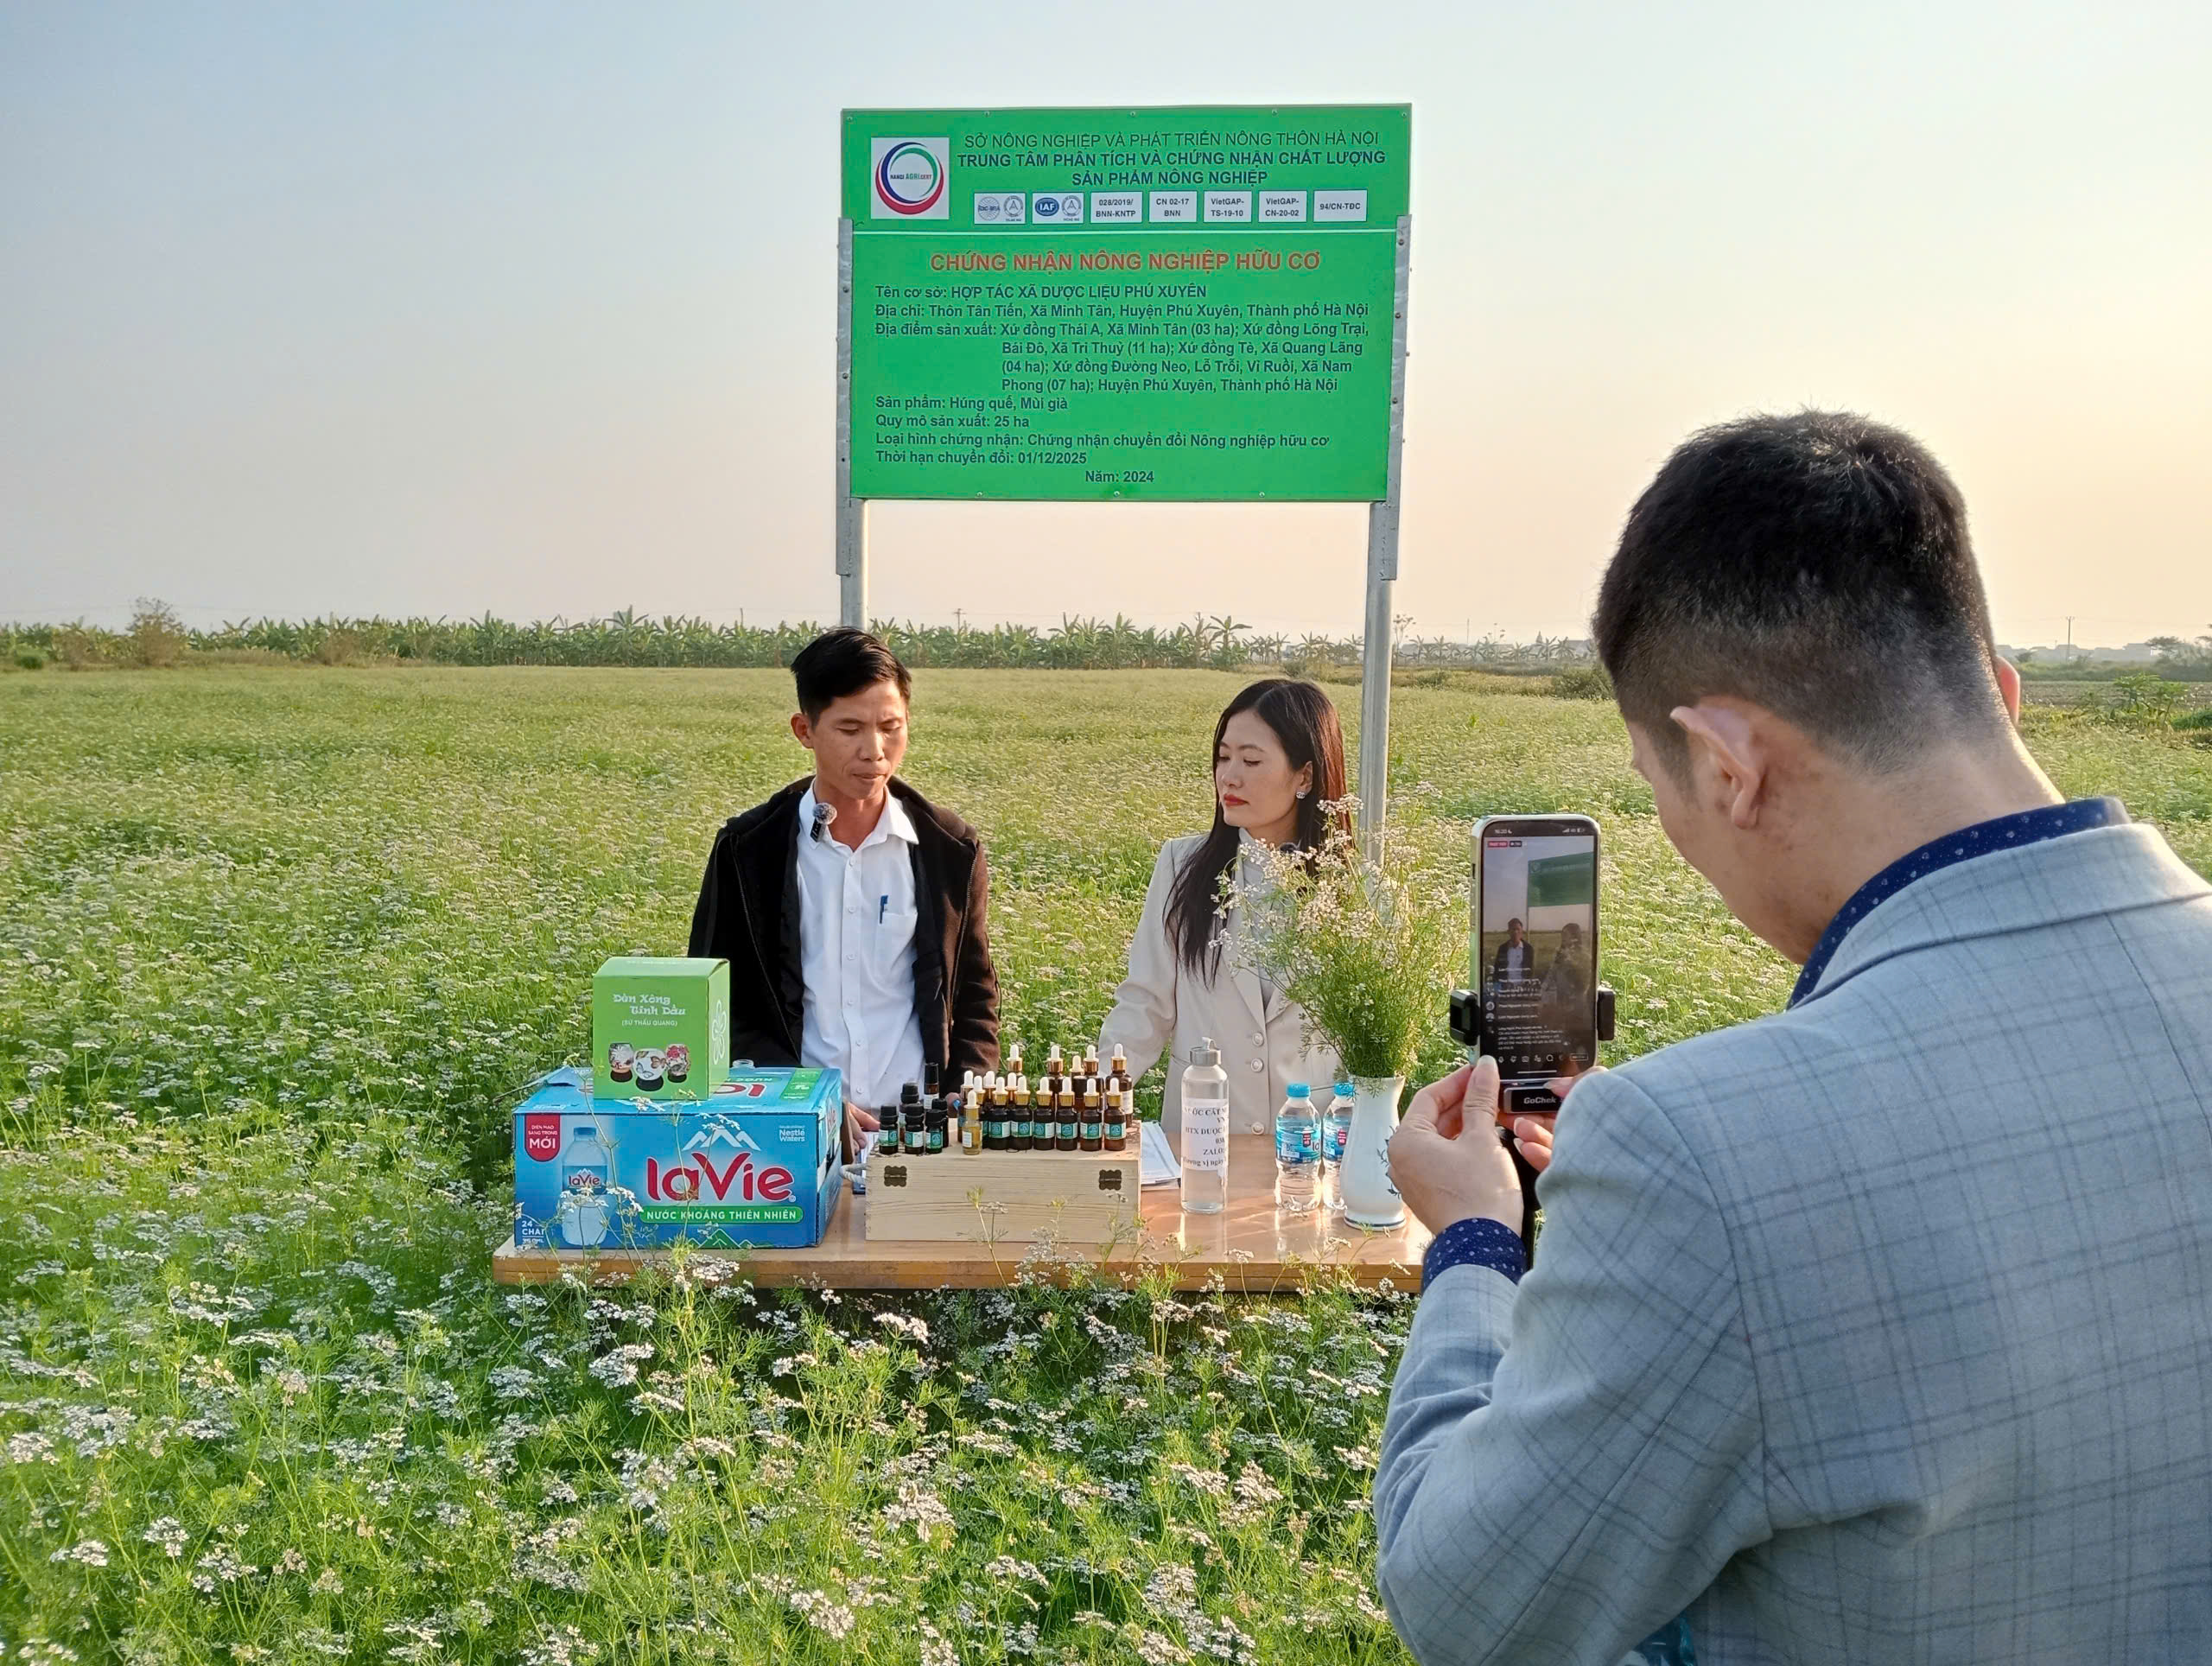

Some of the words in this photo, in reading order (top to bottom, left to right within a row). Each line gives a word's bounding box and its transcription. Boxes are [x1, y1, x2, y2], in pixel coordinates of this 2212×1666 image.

[964, 132, 988, 148] SỞ
[993, 132, 1038, 148] NÔNG
[1042, 132, 1101, 150] NGHIỆP
[1104, 131, 1125, 148] VÀ
[1129, 131, 1171, 147] PHÁT
[1225, 130, 1272, 146] NÔNG
[1276, 130, 1320, 146] THÔN
[1325, 130, 1347, 145] HÀ
[1351, 130, 1379, 147] NỘI
[957, 154, 1012, 167] TRUNG
[1015, 150, 1049, 167] TÂM
[1052, 150, 1096, 167] PHÂN
[1100, 149, 1137, 166] TÍCH
[1141, 149, 1162, 165] VÀ
[1166, 149, 1224, 165] CHỨNG
[1230, 149, 1274, 168] NHẬN
[1278, 149, 1322, 165] CHẤT
[1326, 149, 1386, 167] LƯỢNG
[1072, 169, 1103, 186] SẢN
[1158, 168, 1205, 184] NÔNG
[1209, 168, 1268, 187] NGHIỆP
[1098, 198, 1134, 207] 028/2019/
[1319, 202, 1361, 211] 94/CN-TĐC
[930, 250, 1007, 271] CHỨNG
[1013, 250, 1072, 275] NHẬN
[1079, 249, 1141, 270] NÔNG
[1148, 249, 1230, 274] NGHIỆP
[1236, 249, 1281, 270] HỮU
[1287, 251, 1321, 270] CƠ
[875, 285, 900, 298] Tên
[904, 289, 922, 298] cơ
[951, 285, 982, 302] HỢP
[986, 283, 1014, 298] TÁC
[1017, 283, 1038, 298] XÃ
[1041, 285, 1085, 301] DƯỢC
[1088, 283, 1120, 301] LIỆU
[1124, 282, 1154, 298] PHÚ
[1157, 283, 1206, 297] XUYÊN
[874, 303, 897, 319] Địa
[900, 303, 925, 317] chỉ:
[929, 304, 963, 316] Thôn
[966, 304, 991, 316] Tân
[1029, 304, 1047, 316] Xã
[1051, 304, 1083, 316] Minh
[1087, 304, 1116, 318] Tân,
[1120, 304, 1162, 320] Huyện
[1166, 303, 1193, 316] Phú
[1197, 304, 1243, 320] Xuyên,
[1246, 303, 1289, 316] Thành
[1293, 302, 1319, 319] phố
[1323, 303, 1341, 316] Hà
[1345, 302, 1369, 318] Nội
[874, 322, 897, 338] Địa
[900, 321, 933, 335] điểm
[936, 323, 961, 335] sản
[963, 321, 996, 335] xuất:
[1001, 322, 1020, 335] Xứ
[1023, 321, 1056, 338] đồng
[1090, 323, 1103, 337] A,
[1107, 322, 1124, 335] Xã
[1128, 322, 1160, 335] Minh
[1163, 322, 1187, 335] Tân
[1191, 323, 1211, 338] (03
[1214, 323, 1239, 338] ha);
[1243, 322, 1263, 335] Xứ
[1266, 321, 1300, 337] đồng
[1341, 321, 1369, 337] Trại,
[1051, 341, 1068, 353] Xã
[1128, 341, 1146, 356] (11
[1150, 341, 1175, 356] ha);
[1178, 341, 1198, 353] Xứ
[1201, 340, 1235, 356] đồng
[1262, 341, 1278, 353] Xã
[1281, 341, 1326, 356] Quang
[1001, 360, 1021, 375] (04
[1025, 360, 1049, 375] ha);
[1052, 360, 1072, 372] Xứ
[1075, 358, 1108, 375] đồng
[1111, 360, 1158, 375] Đường
[1161, 360, 1191, 374] Neo,
[1300, 359, 1319, 372] Xã
[1322, 359, 1352, 372] Nam
[1001, 378, 1044, 394] Phong
[1046, 378, 1066, 393] (07
[1070, 378, 1094, 393] ha);
[1098, 378, 1140, 394] Huyện
[1143, 378, 1168, 391] Phú
[1172, 378, 1217, 393] Xuyên,
[1220, 378, 1262, 391] Thành
[1265, 376, 1291, 393] phố
[1294, 378, 1312, 391] Hà
[1315, 378, 1338, 394] Nội
[875, 395, 901, 409] Sản
[905, 393, 946, 411] phẩm:
[950, 397, 985, 411] Húng
[988, 395, 1017, 411] quế,
[1020, 397, 1044, 409] Mùi
[875, 415, 903, 429] Quy
[906, 416, 927, 427] mô
[930, 415, 954, 427] sản
[957, 412, 990, 427] xuất:
[994, 416, 1010, 427] 25
[1014, 415, 1029, 427] ha
[875, 433, 904, 448] Loại
[907, 433, 937, 445] hình
[940, 433, 982, 448] chứng
[986, 434, 1023, 448] nhận:
[1027, 434, 1073, 448] Chứng
[1077, 434, 1109, 448] nhận
[1113, 431, 1162, 448] chuyển
[1190, 434, 1226, 448] Nông
[1230, 434, 1275, 448] nghiệp
[1279, 434, 1307, 446] hữu
[1311, 436, 1330, 446] cơ
[875, 450, 906, 462] Thời
[910, 450, 934, 466] hạn
[938, 448, 986, 466] chuyển
[1018, 452, 1087, 464] 01/12/2025
[1084, 470, 1120, 483] Năm:
[1122, 470, 1154, 483] 2024
[529, 1135, 556, 1149] MỚI
[568, 1174, 601, 1186] laVie
[646, 1151, 794, 1202] laVie
[646, 1210, 677, 1220] NƯỚC
[680, 1209, 726, 1220] KHOÁNG
[729, 1209, 760, 1220] THIÊN
[764, 1209, 797, 1220] NHIÊN
